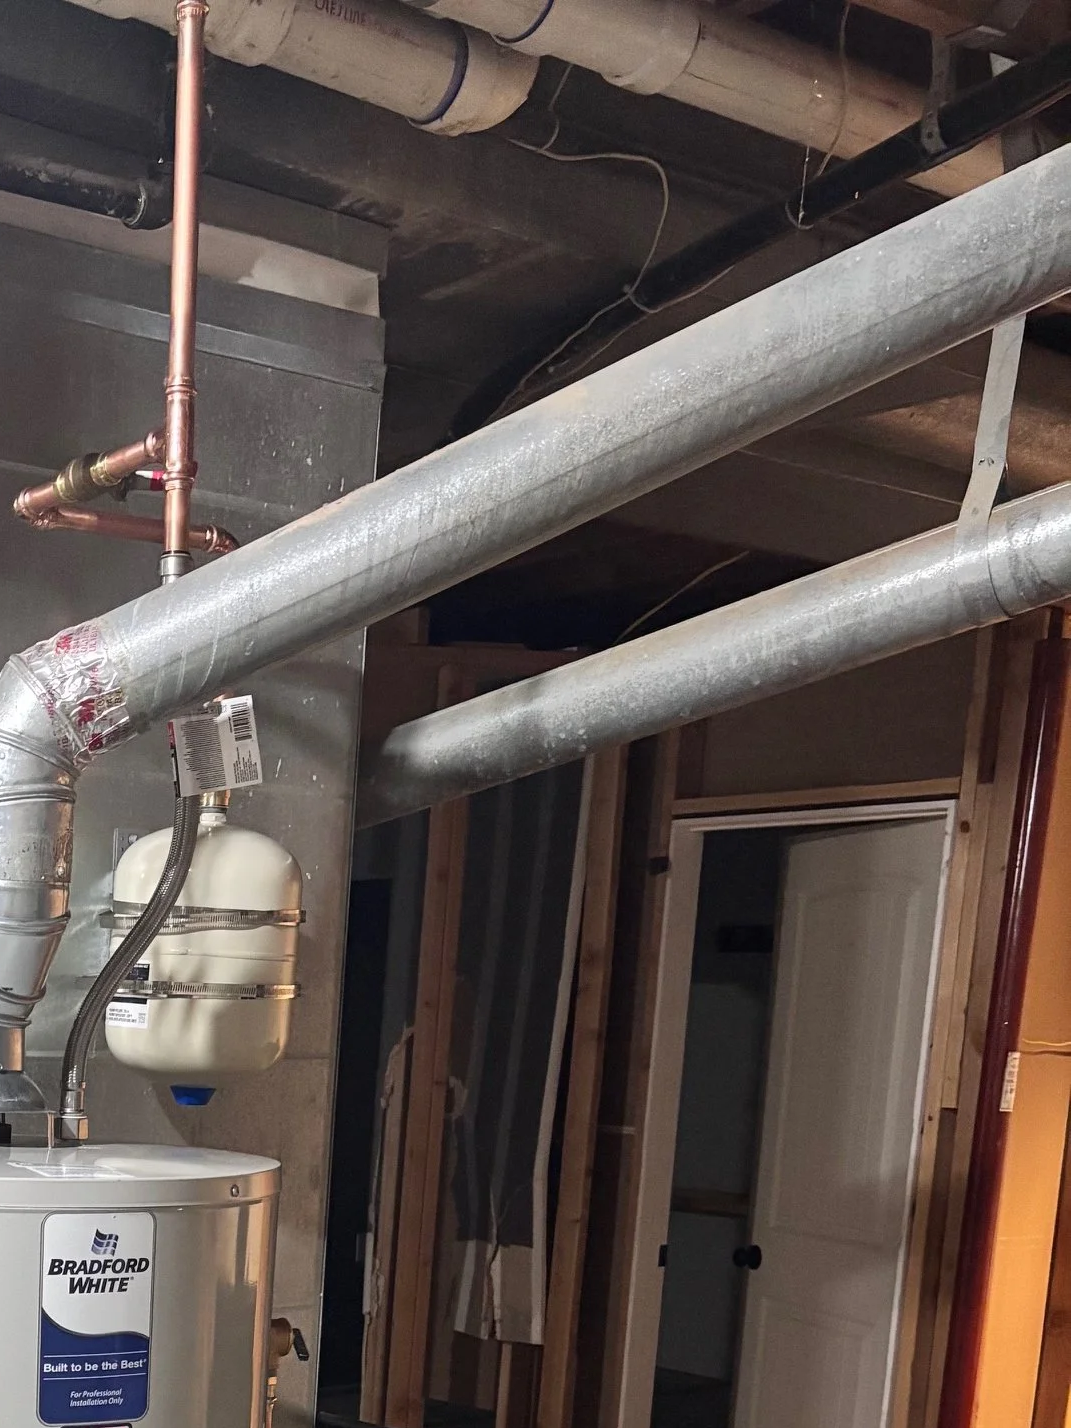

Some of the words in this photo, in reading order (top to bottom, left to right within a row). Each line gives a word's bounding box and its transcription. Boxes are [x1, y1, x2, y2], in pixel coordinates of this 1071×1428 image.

[48, 1258, 149, 1275] BRADFORD
[69, 1277, 129, 1294] WHITE
[44, 1364, 67, 1372] Built
[71, 1363, 81, 1371] to
[85, 1363, 98, 1371] be
[102, 1361, 117, 1370] the
[121, 1360, 143, 1369] Best
[82, 1388, 122, 1397] Professional
[70, 1399, 107, 1407] Installation
[109, 1397, 123, 1405] Only
